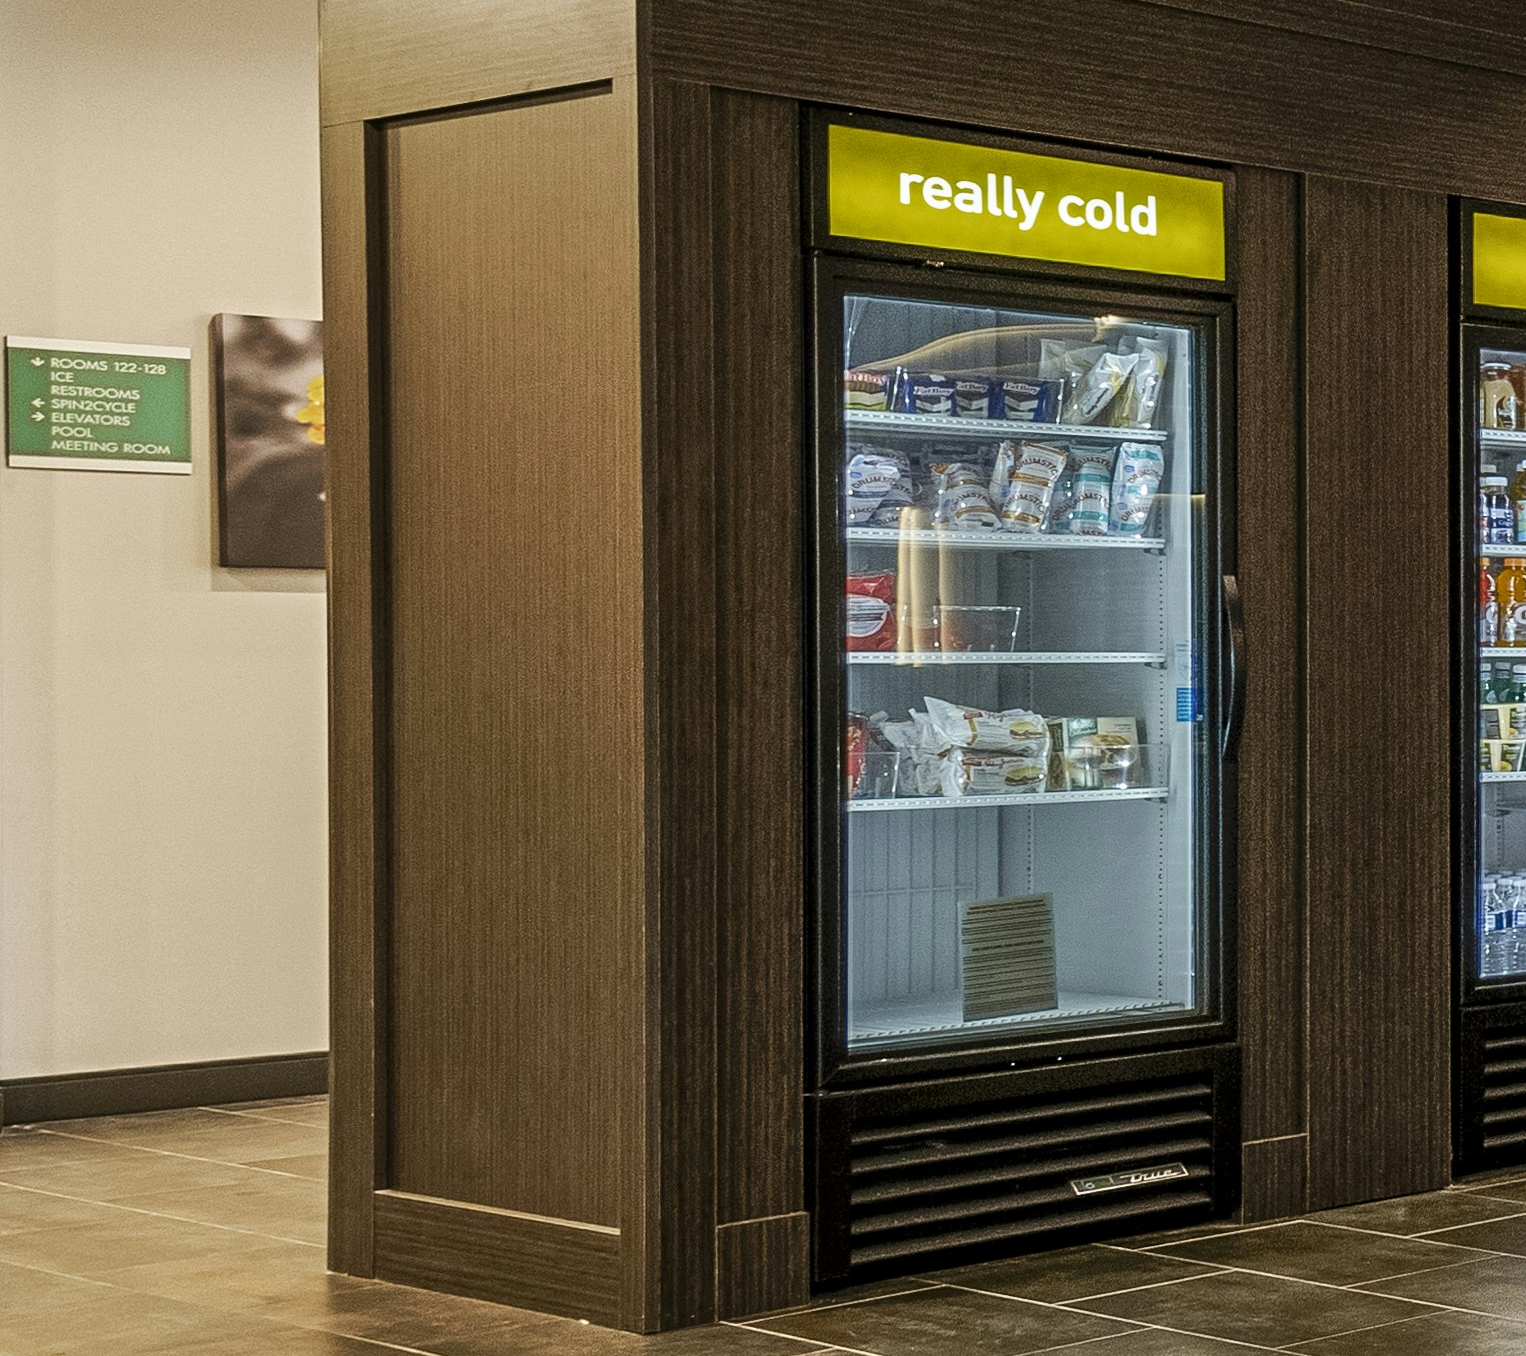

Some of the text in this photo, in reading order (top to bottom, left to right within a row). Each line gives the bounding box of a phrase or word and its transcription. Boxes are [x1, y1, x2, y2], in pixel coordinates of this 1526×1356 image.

[900, 172, 1157, 236] really cold
[51, 358, 167, 375] ROOMS 122-128
[51, 372, 74, 382] ICE
[51, 385, 140, 400] RESTROOMS
[51, 399, 136, 413] SPIN2CYCLE
[51, 413, 131, 426] ELEVATORS
[52, 426, 93, 438] POOL
[51, 440, 171, 455] MEETING ROOM
